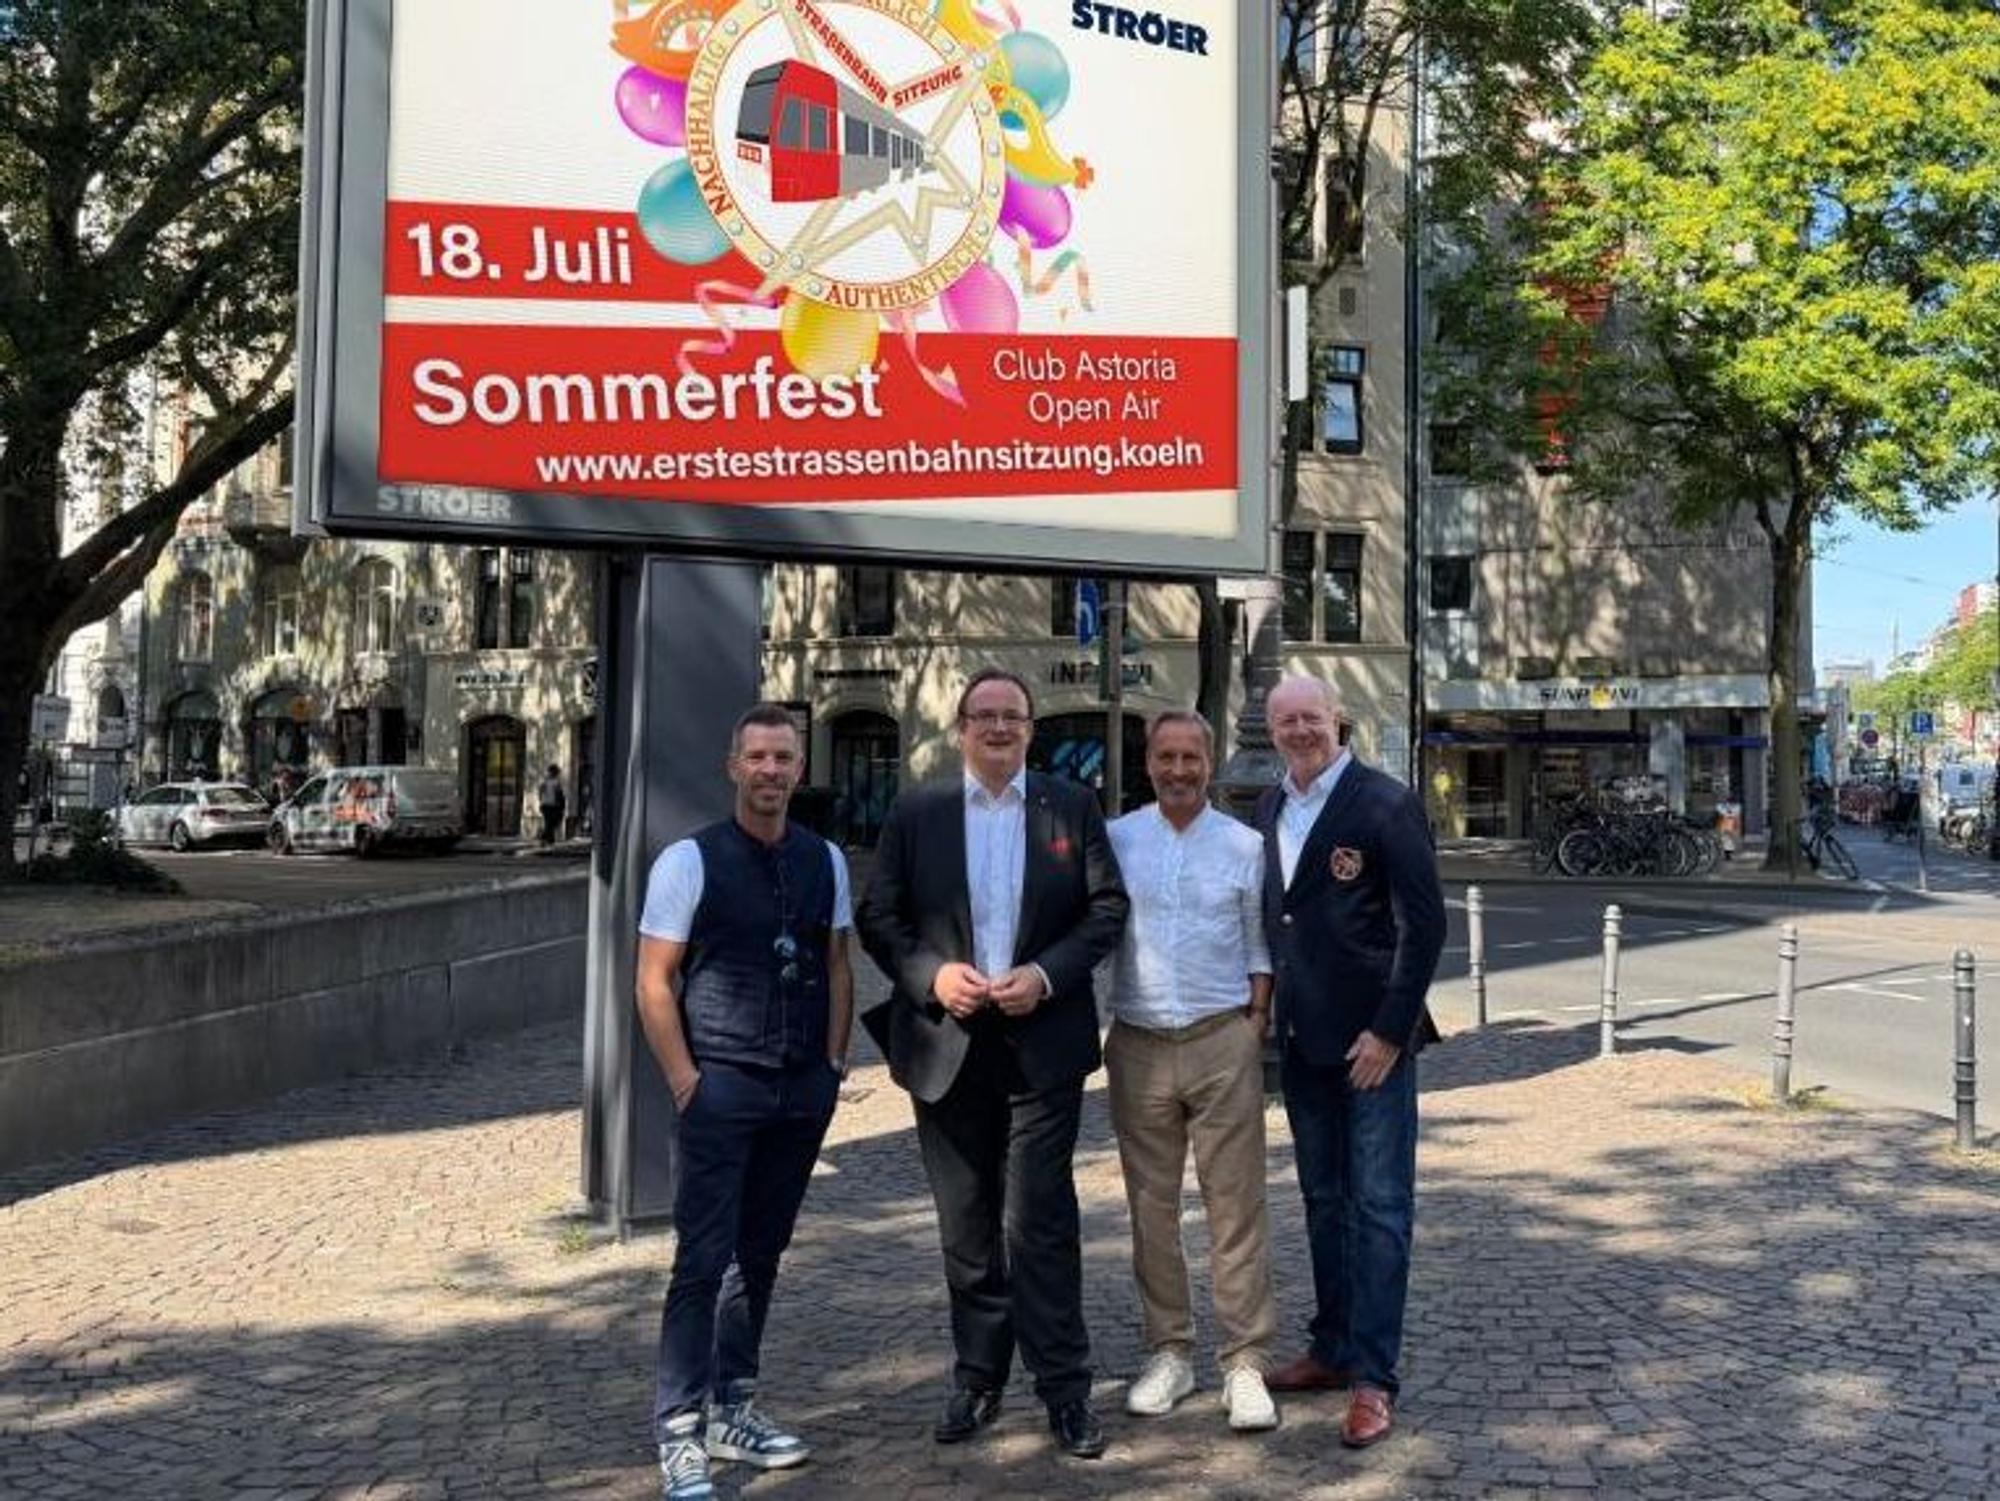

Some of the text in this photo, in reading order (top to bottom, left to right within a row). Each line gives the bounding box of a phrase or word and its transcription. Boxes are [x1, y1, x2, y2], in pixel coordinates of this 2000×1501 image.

[892, 65, 963, 108] SITZUNG
[688, 41, 733, 216] NACHHALTIG
[407, 222, 633, 285] 18. Juli
[825, 231, 985, 308] AUTHENTISCH
[412, 356, 883, 427] Sommerfest
[994, 349, 1177, 382] Club Astoria
[1029, 391, 1162, 430] Open Air
[536, 436, 1204, 483] www.erstestrassenbahnsitzung.koeln
